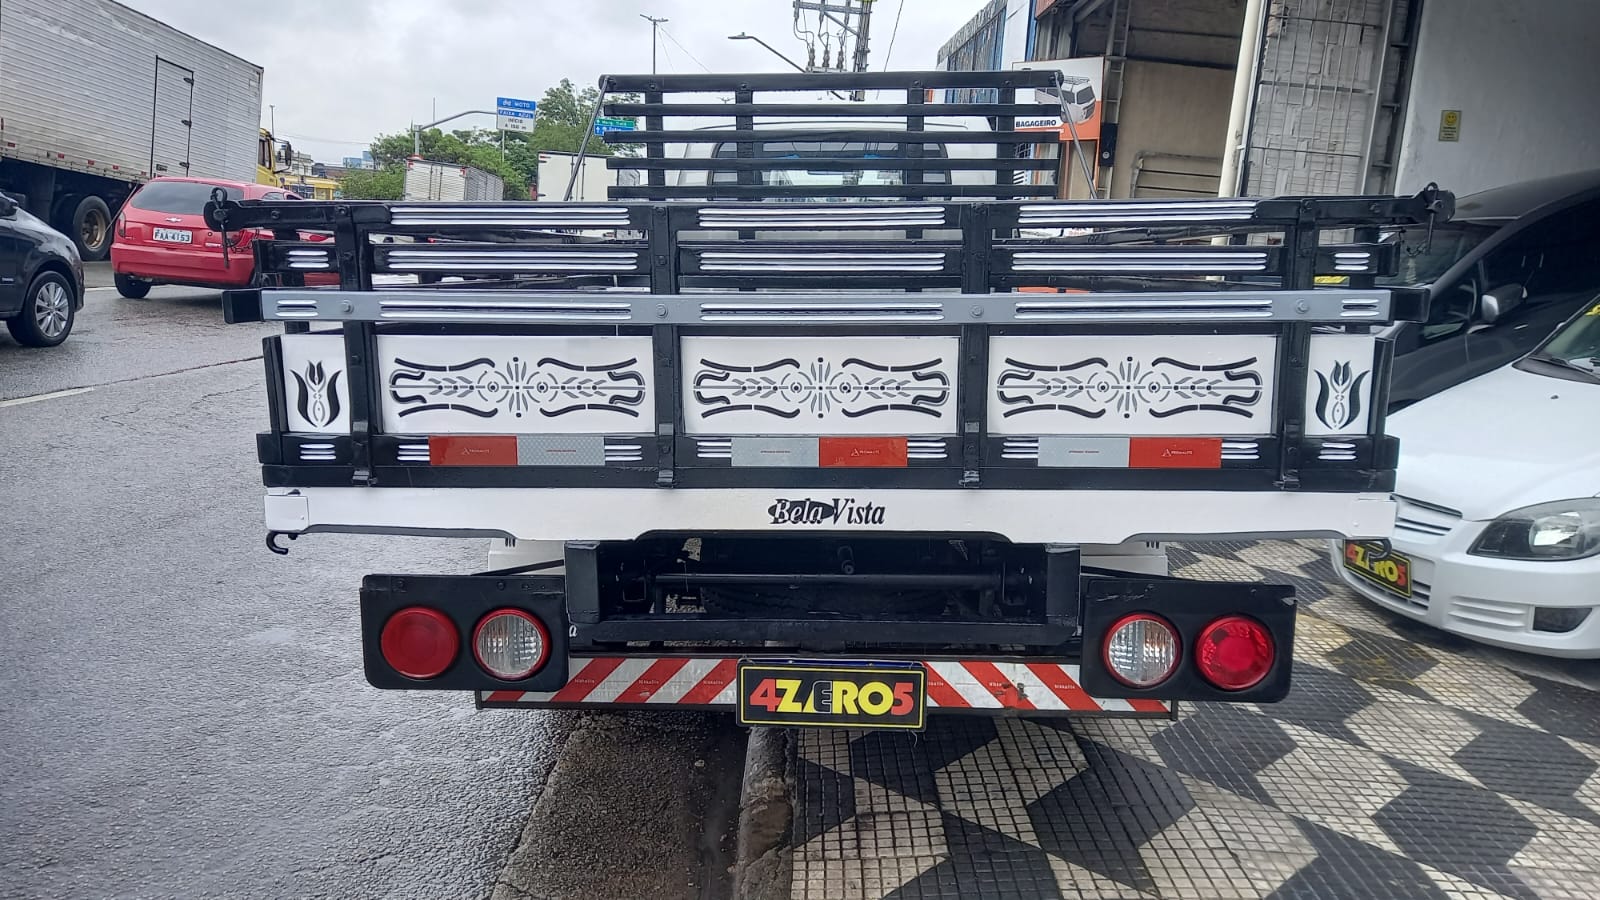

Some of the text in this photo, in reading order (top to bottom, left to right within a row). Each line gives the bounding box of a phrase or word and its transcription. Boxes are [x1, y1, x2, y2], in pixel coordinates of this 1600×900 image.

[769, 498, 886, 525] Bela Vista
[749, 678, 915, 717] 4ZERO5
